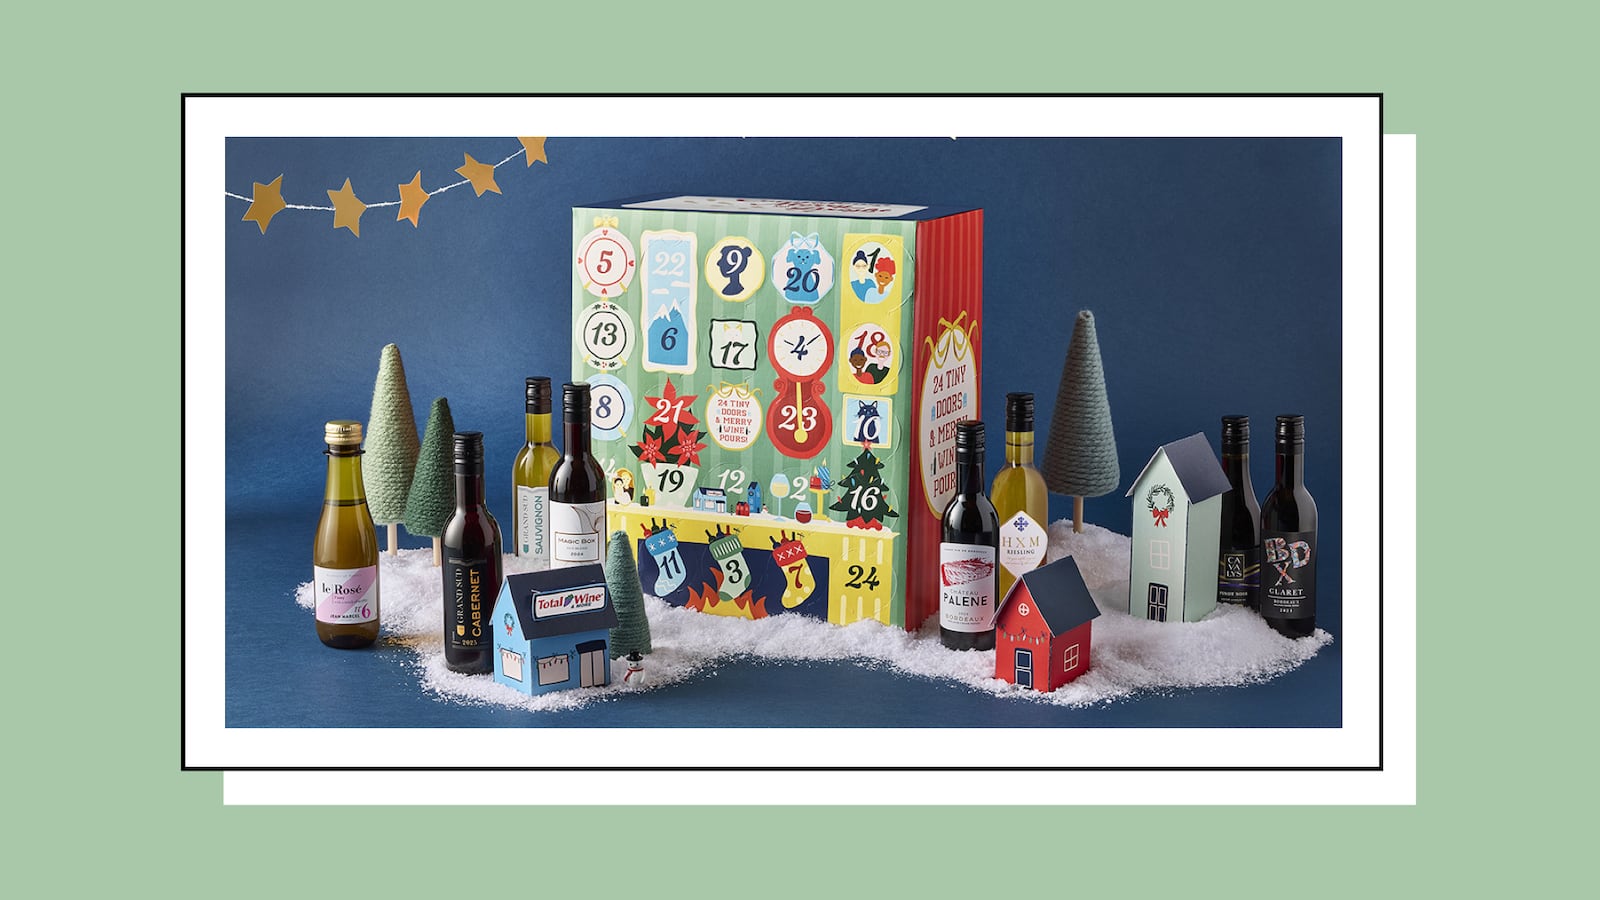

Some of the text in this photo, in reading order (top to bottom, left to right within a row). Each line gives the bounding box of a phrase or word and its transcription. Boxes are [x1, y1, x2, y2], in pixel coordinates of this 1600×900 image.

[596, 250, 613, 274] 5
[651, 251, 686, 277] 22
[726, 249, 743, 274] 9
[867, 247, 881, 274] 1
[783, 267, 820, 293] 20
[591, 322, 618, 347] 13
[660, 327, 678, 351] 6
[854, 330, 885, 358] 18
[720, 341, 749, 366] 17
[790, 335, 808, 361] 4
[933, 364, 967, 395] 24 TINY
[596, 395, 612, 419] 8
[653, 398, 684, 424] 21
[717, 399, 750, 408] 24 TINY
[721, 408, 747, 417] DOORS
[936, 392, 963, 419] DOORS
[723, 417, 753, 426] MERRY
[723, 425, 745, 434] WINE
[778, 405, 818, 431] 23
[853, 414, 881, 441] 10
[719, 434, 748, 443] POURS!
[929, 429, 936, 448] &
[938, 446, 957, 471] WIN
[658, 469, 685, 493] 19
[717, 469, 746, 494] 12
[790, 476, 809, 501] 2
[850, 485, 881, 511] 16
[534, 495, 543, 555] SAUVIGNON
[659, 550, 682, 580] 11
[725, 559, 743, 584] 3
[788, 563, 804, 589] 7
[844, 564, 880, 591] 24
[322, 582, 362, 595] le Rosé
[455, 568, 464, 624] GRAND SUD
[943, 592, 988, 607] PALENE
[1268, 587, 1303, 596] CLARET
[470, 568, 481, 637] CABERNET
[538, 596, 564, 610] Total
[945, 613, 985, 622] BORDEAUX
